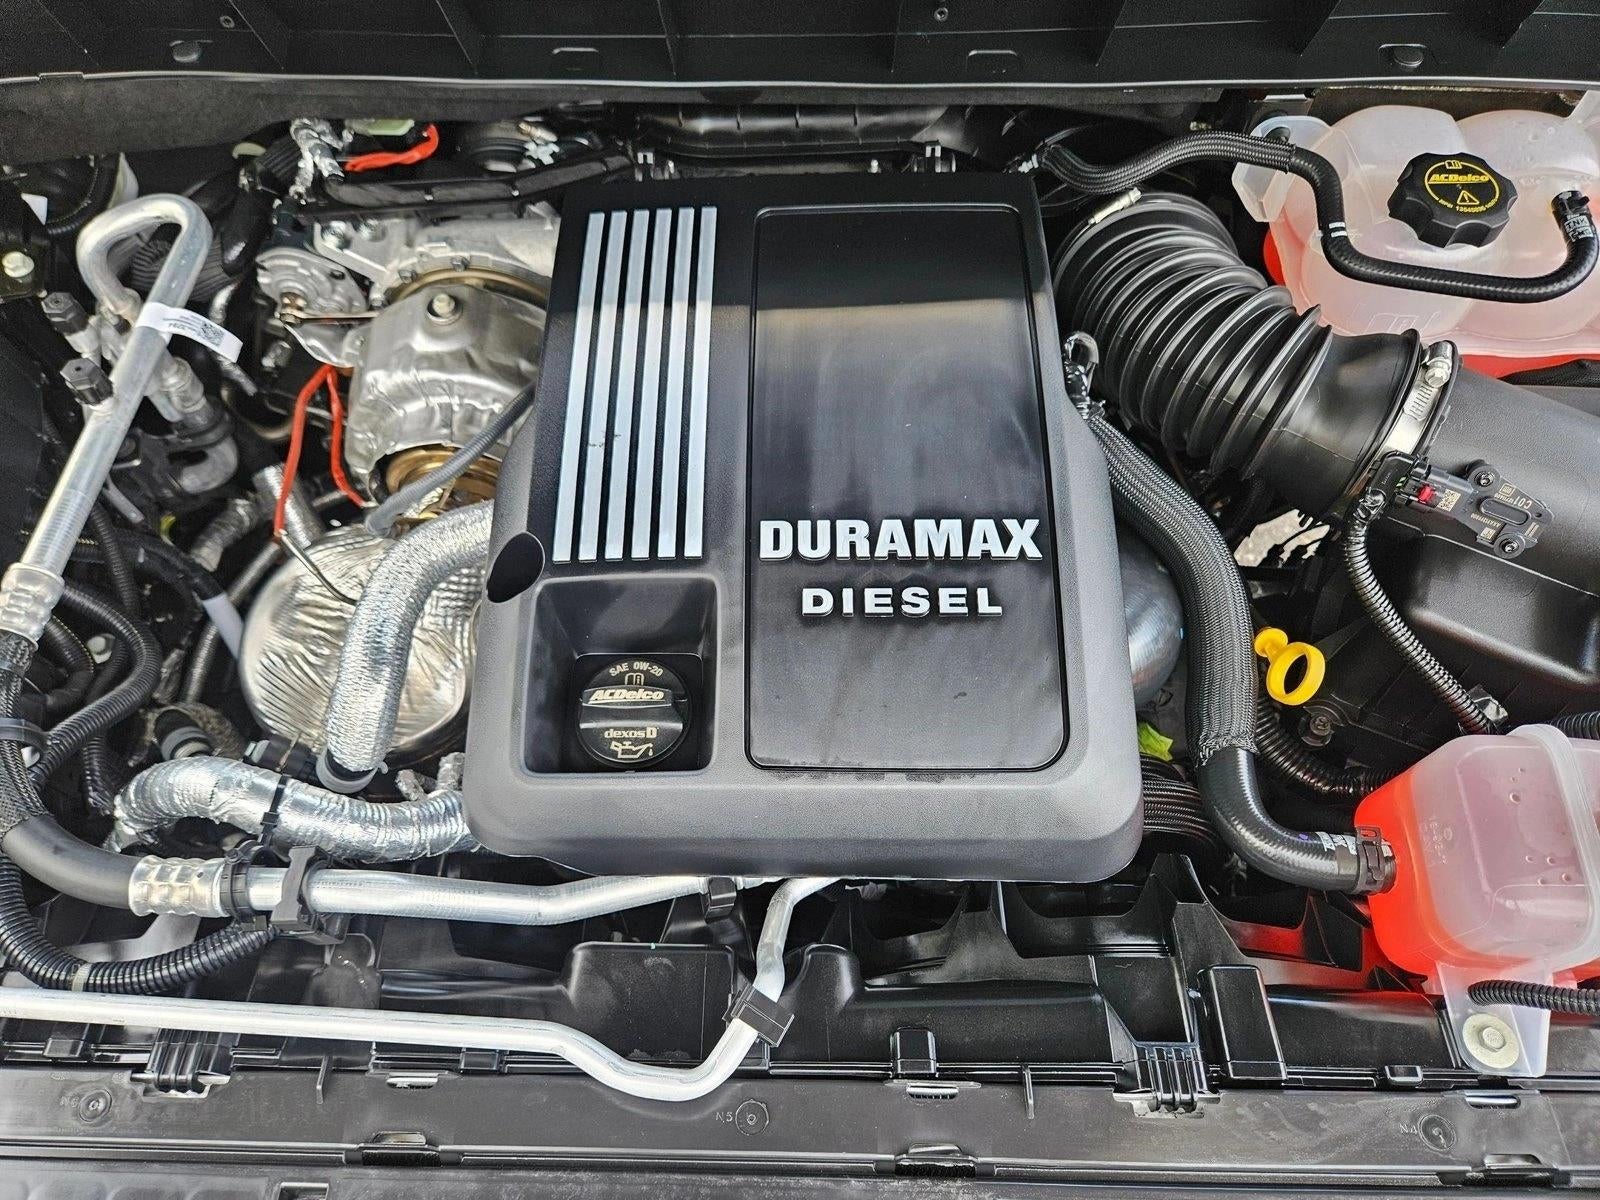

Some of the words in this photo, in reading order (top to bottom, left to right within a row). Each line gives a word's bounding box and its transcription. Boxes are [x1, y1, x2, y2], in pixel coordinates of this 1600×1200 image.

[1428, 174, 1490, 183] ACDelco
[759, 518, 1043, 560] DURAMAX
[801, 587, 1003, 617] DIESEL
[609, 663, 629, 677] SAE
[633, 662, 664, 677] 0W-20
[588, 689, 665, 702] ACDelco
